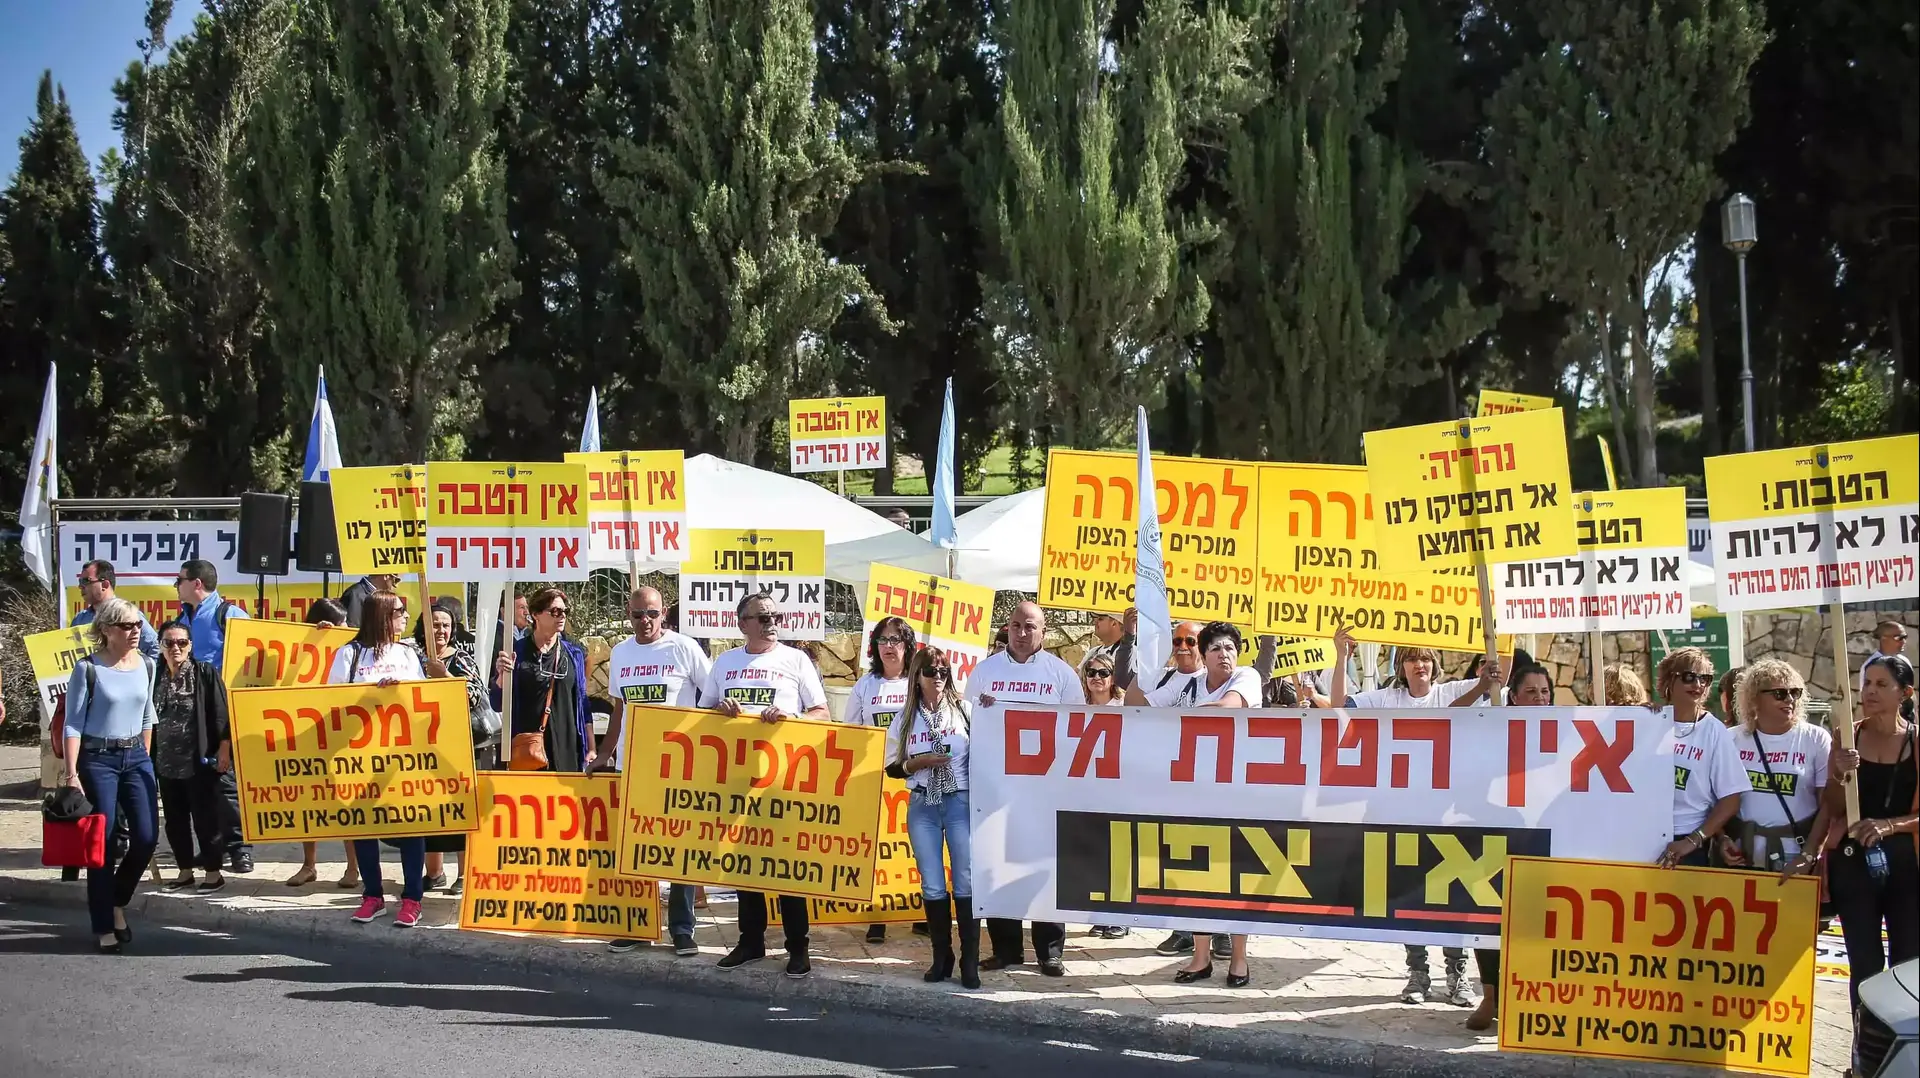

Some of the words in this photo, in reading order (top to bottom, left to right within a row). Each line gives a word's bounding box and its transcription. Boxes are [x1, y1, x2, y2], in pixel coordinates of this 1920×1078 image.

[796, 411, 849, 432] הטבה
[857, 410, 879, 433] אין
[796, 443, 849, 465] נהריה
[856, 442, 880, 464] אין
[1420, 443, 1516, 480] נהריה:
[1795, 458, 1813, 466] נהריה
[1832, 454, 1853, 462] עיריית
[374, 487, 426, 509] ריה:
[589, 472, 639, 500] הטב
[647, 471, 676, 505] אין
[1522, 483, 1557, 509] אל
[1762, 470, 1889, 511] הטבות!
[439, 484, 528, 515] הטבה
[541, 484, 578, 520] אין
[1073, 468, 1248, 530] למכרה
[1385, 497, 1418, 525] לנו
[1427, 487, 1513, 524] תפסיקו
[1288, 489, 1373, 539] ירה
[346, 520, 372, 539] לנו
[379, 520, 426, 542] פסיקו
[588, 521, 640, 550] נהרי
[649, 521, 680, 555] אין
[1076, 525, 1126, 550] הצפון
[1504, 521, 1541, 548] את
[1576, 517, 1642, 545] הטב
[1726, 521, 1821, 559] להיות
[1834, 516, 1885, 550] לא
[75, 533, 200, 567] מפקירה
[437, 538, 526, 568] נהריה
[540, 538, 579, 573] אין
[1170, 533, 1236, 557] מוכרים
[1418, 526, 1494, 561] החמצן
[714, 550, 793, 571] הטבות!
[1047, 545, 1100, 574] ישראל
[1106, 551, 1174, 578] משלת
[1295, 545, 1352, 572] הצפון
[1596, 556, 1639, 584] לא
[1651, 556, 1680, 582] או
[1194, 563, 1253, 586] פרטים
[1261, 567, 1323, 595] ישראל
[1505, 558, 1584, 587] להיות
[1728, 569, 1777, 596] בנהריה
[1780, 566, 1811, 591] המס
[1815, 561, 1862, 588] הטבות
[1865, 555, 1914, 589] לקיצוץ
[689, 580, 749, 602] להיות
[799, 583, 820, 603] או
[1049, 576, 1086, 601] צפון
[1092, 580, 1136, 605] ס-אין
[1330, 572, 1407, 601] ממשלת
[1431, 584, 1495, 606] רטים
[874, 583, 944, 626] הטבה
[1227, 593, 1253, 618] אין
[1267, 601, 1308, 628] צפון
[1505, 598, 1546, 620] בנהריה
[1549, 597, 1575, 618] המס
[1579, 595, 1618, 617] הטבות
[1621, 591, 1661, 620] לקיצוץ
[1665, 591, 1683, 615] לא
[688, 610, 718, 627] בנהריה
[808, 611, 820, 630] לא
[950, 600, 983, 635] אין
[1315, 605, 1385, 632] מס-אין
[1393, 610, 1459, 635] הטבת
[1468, 616, 1497, 644] ין
[1304, 648, 1324, 663] את
[620, 667, 631, 677] מס
[633, 665, 658, 676] הטבת
[662, 665, 674, 677] אין
[726, 670, 737, 680] מס
[740, 669, 767, 679] הטבת
[624, 686, 645, 699] צפון
[648, 686, 663, 701] אין
[755, 689, 771, 704] אין
[886, 694, 907, 703] טבת
[992, 680, 1005, 692] מס
[1008, 680, 1036, 693] הטבת
[1039, 682, 1053, 695] אין
[263, 687, 441, 752] למכירה
[1003, 710, 1126, 779] מס
[1170, 716, 1450, 789] הטבת
[1687, 746, 1704, 760] אין
[1740, 750, 1754, 761] מס
[274, 757, 327, 783] הצפון
[335, 755, 364, 775] את
[371, 751, 438, 773] מוכרים
[659, 730, 854, 797] למכירה
[1506, 719, 1635, 808] אין
[1758, 752, 1788, 763] הטב
[1792, 752, 1805, 765] אין
[246, 782, 304, 804] ישראל
[311, 779, 381, 801] ממשלת
[401, 772, 471, 797] לפרטים
[664, 787, 721, 814] הצפון
[729, 794, 762, 817] את
[770, 798, 841, 825] מוכרים
[257, 810, 296, 835] צפון
[302, 808, 365, 833] מס-אין
[373, 804, 432, 824] הטבת
[439, 802, 467, 827] אין
[630, 808, 691, 838] ישראל
[698, 816, 774, 847] ממשלת
[547, 847, 571, 867] את
[633, 843, 675, 870] צפון
[796, 832, 872, 858] לפרטים
[497, 846, 541, 870] הצפון
[576, 848, 615, 869] וכרים
[682, 848, 751, 875] מס-אין
[759, 857, 823, 884] הטבת
[1089, 820, 1312, 902] צפון.
[472, 867, 519, 891] ישראל
[524, 869, 582, 894] ממשלת
[830, 865, 860, 892] אין
[1362, 830, 1503, 918] אין
[598, 877, 653, 899] לפרטים
[473, 898, 508, 923] צפון
[513, 900, 567, 925] מס-אין
[572, 904, 621, 924] הטבת
[880, 892, 922, 911] טבת
[627, 907, 648, 932] אין
[1544, 879, 1778, 954] למכירה
[1551, 948, 1618, 978] הצפון
[1628, 954, 1667, 979] את
[1677, 958, 1765, 987] מוכרים
[1511, 972, 1584, 1005] ישראל
[1592, 980, 1683, 1013] ממשלת
[1712, 995, 1806, 1025] לפרטים
[1518, 1012, 1567, 1042] צפון
[1576, 1015, 1658, 1047] מס-אין
[1668, 1026, 1746, 1052] הטבת
[1757, 1032, 1793, 1063] אין
